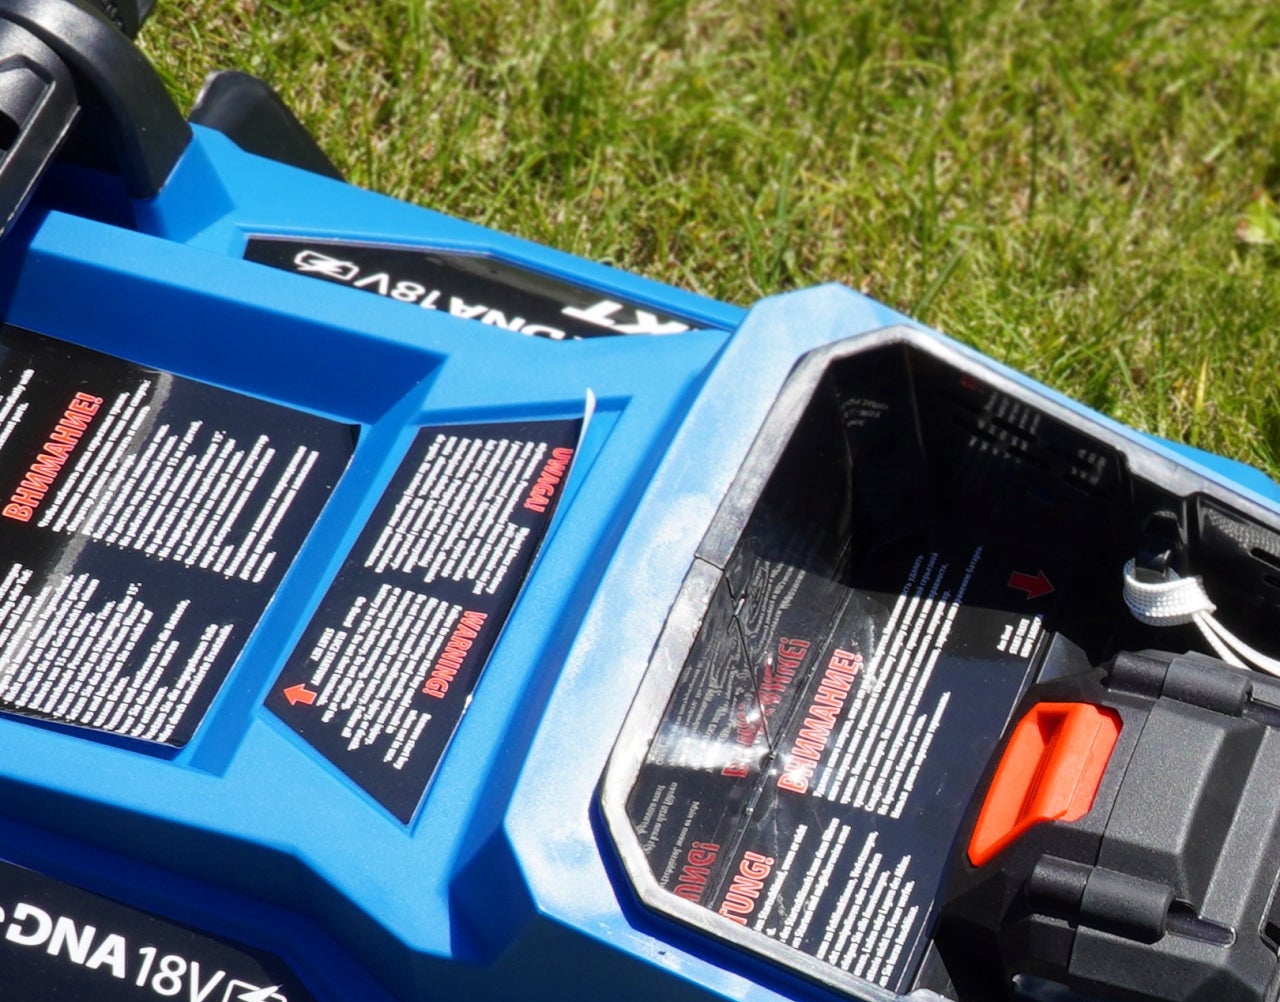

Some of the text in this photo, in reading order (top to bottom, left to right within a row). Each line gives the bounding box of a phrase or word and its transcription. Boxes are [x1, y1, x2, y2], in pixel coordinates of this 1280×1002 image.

[2, 392, 103, 522] ВНИМАНИЕ!
[524, 448, 573, 512] UWAGA!
[422, 611, 487, 698] WARNING!
[777, 649, 864, 793] ВНИМАНИЕ!
[716, 851, 775, 926] TUNG!
